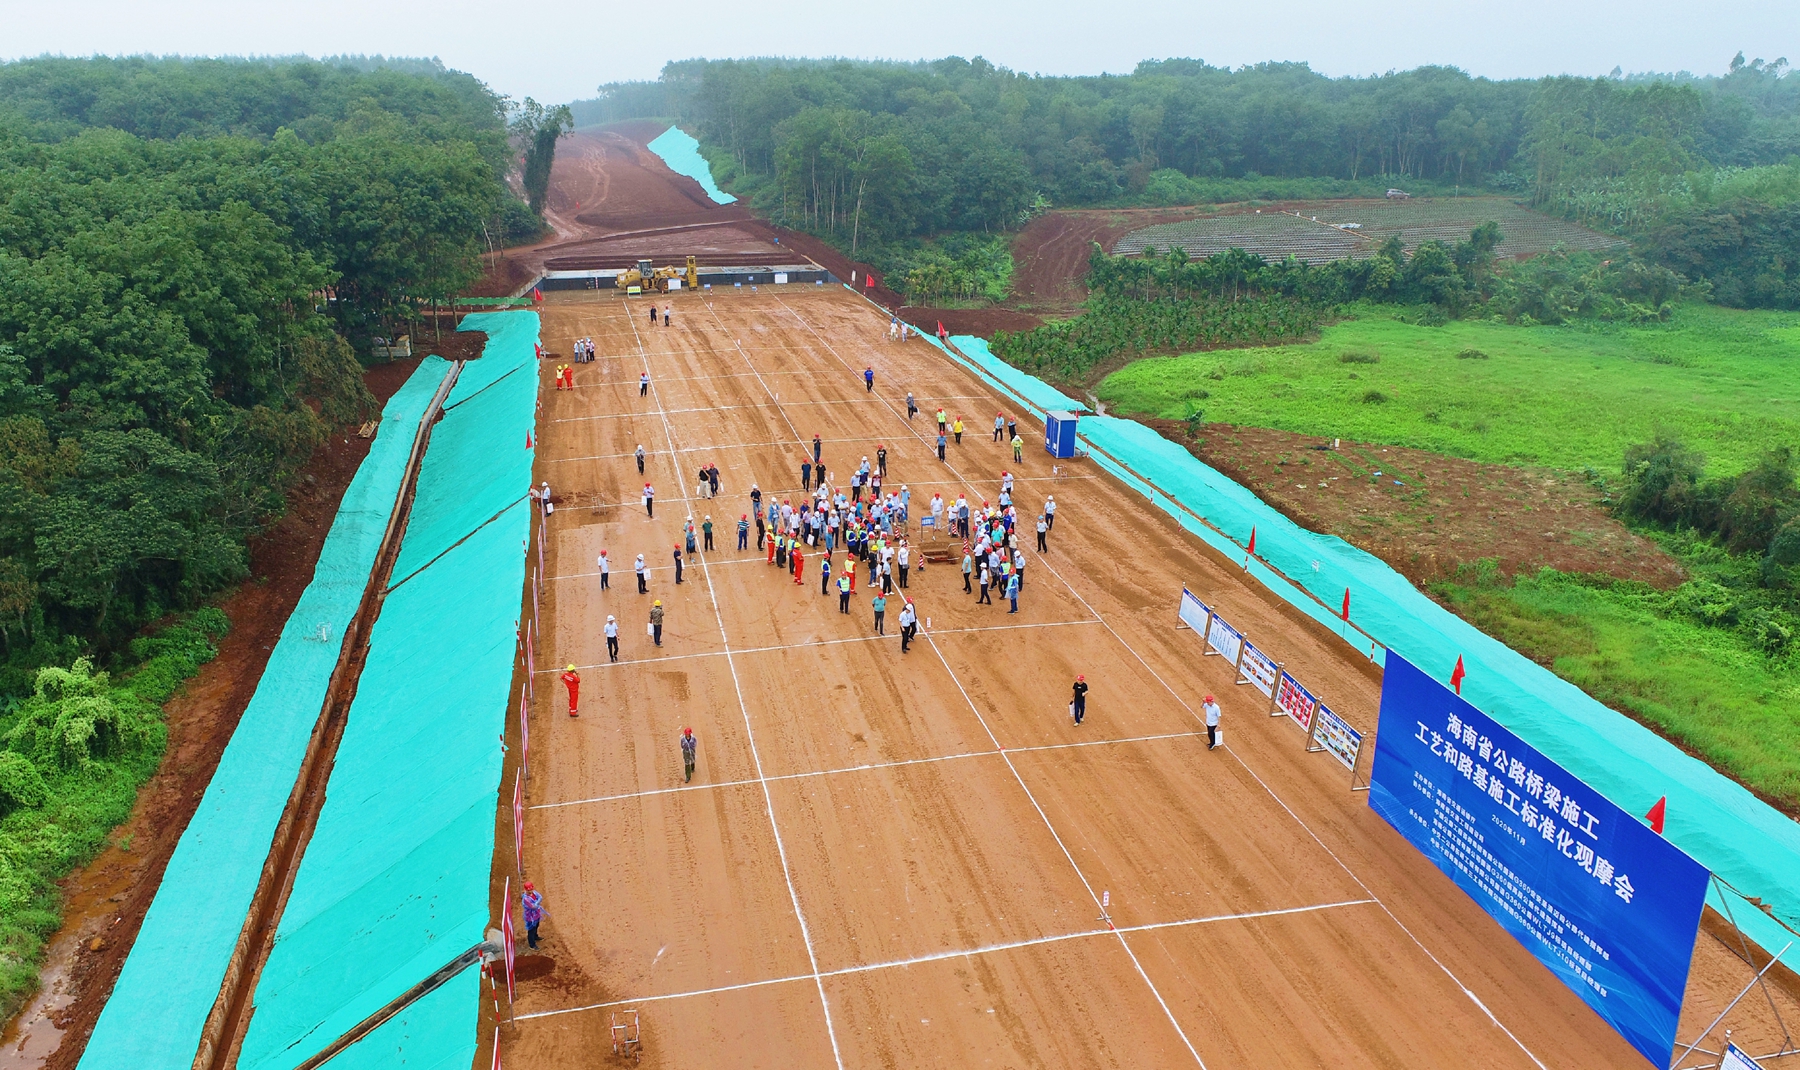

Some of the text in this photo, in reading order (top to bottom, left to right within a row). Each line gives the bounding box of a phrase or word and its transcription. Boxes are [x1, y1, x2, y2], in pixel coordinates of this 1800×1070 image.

[1414, 720, 1634, 903] 工艺和路基施工标准化观摩会
[1446, 712, 1599, 840] 海南省公路桥梁施工
[1491, 814, 1525, 845] 2020年11月
